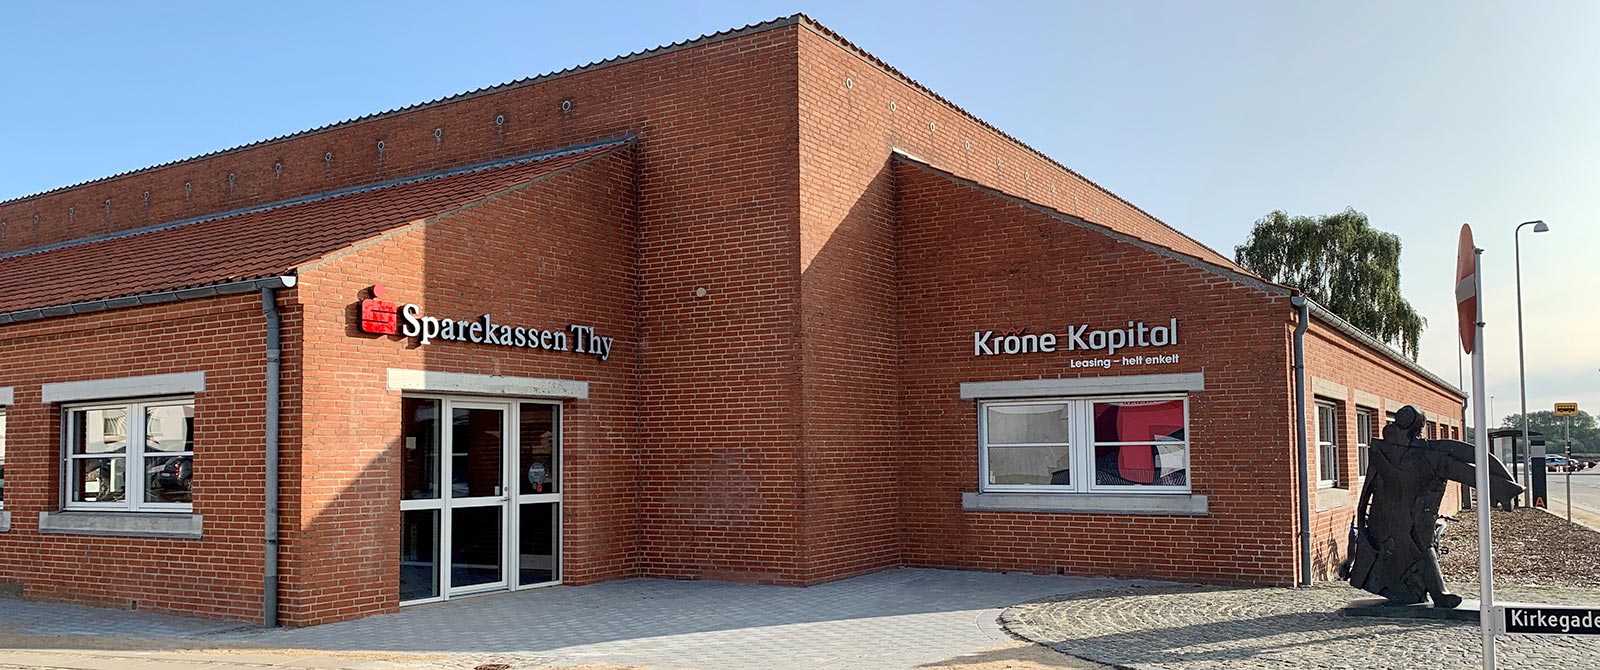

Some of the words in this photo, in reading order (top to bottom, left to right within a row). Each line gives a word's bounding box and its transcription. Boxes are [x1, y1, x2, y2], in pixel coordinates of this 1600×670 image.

[402, 303, 568, 351] Sparekassen
[570, 324, 614, 361] Thy
[974, 330, 1056, 356] Krone
[1068, 317, 1177, 355] Kapital
[1070, 358, 1111, 369] Leasing
[1122, 355, 1143, 366] helt
[1145, 354, 1179, 365] enkelt
[1535, 497, 1545, 508] A
[1511, 609, 1600, 632] Kirkegade
